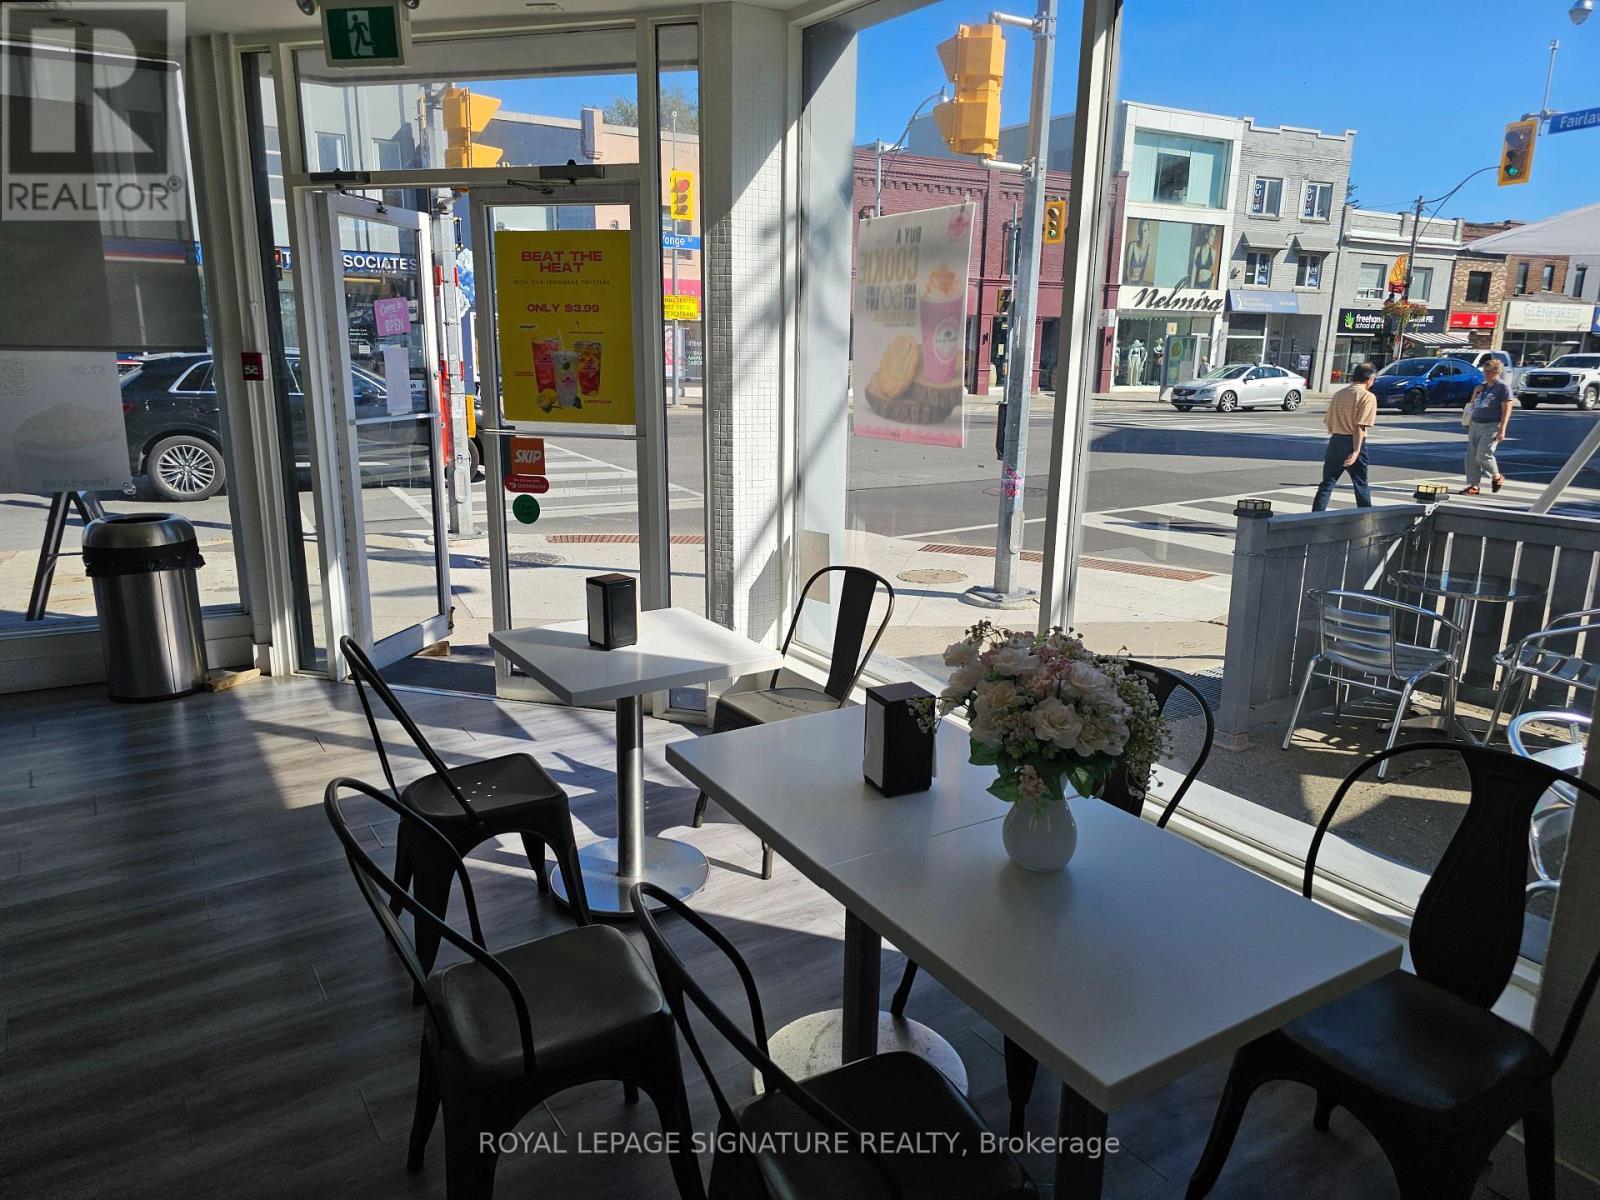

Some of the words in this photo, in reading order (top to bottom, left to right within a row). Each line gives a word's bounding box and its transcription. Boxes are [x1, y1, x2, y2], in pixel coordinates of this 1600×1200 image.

[521, 251, 564, 262] BEAT
[569, 251, 603, 262] THE
[539, 263, 585, 273] HEAT
[1133, 275, 1224, 311] Nelmira
[527, 304, 560, 313] ONLY
[564, 304, 600, 313] $3.99
[385, 318, 404, 332] OPEN
[514, 449, 542, 464] SKIP
